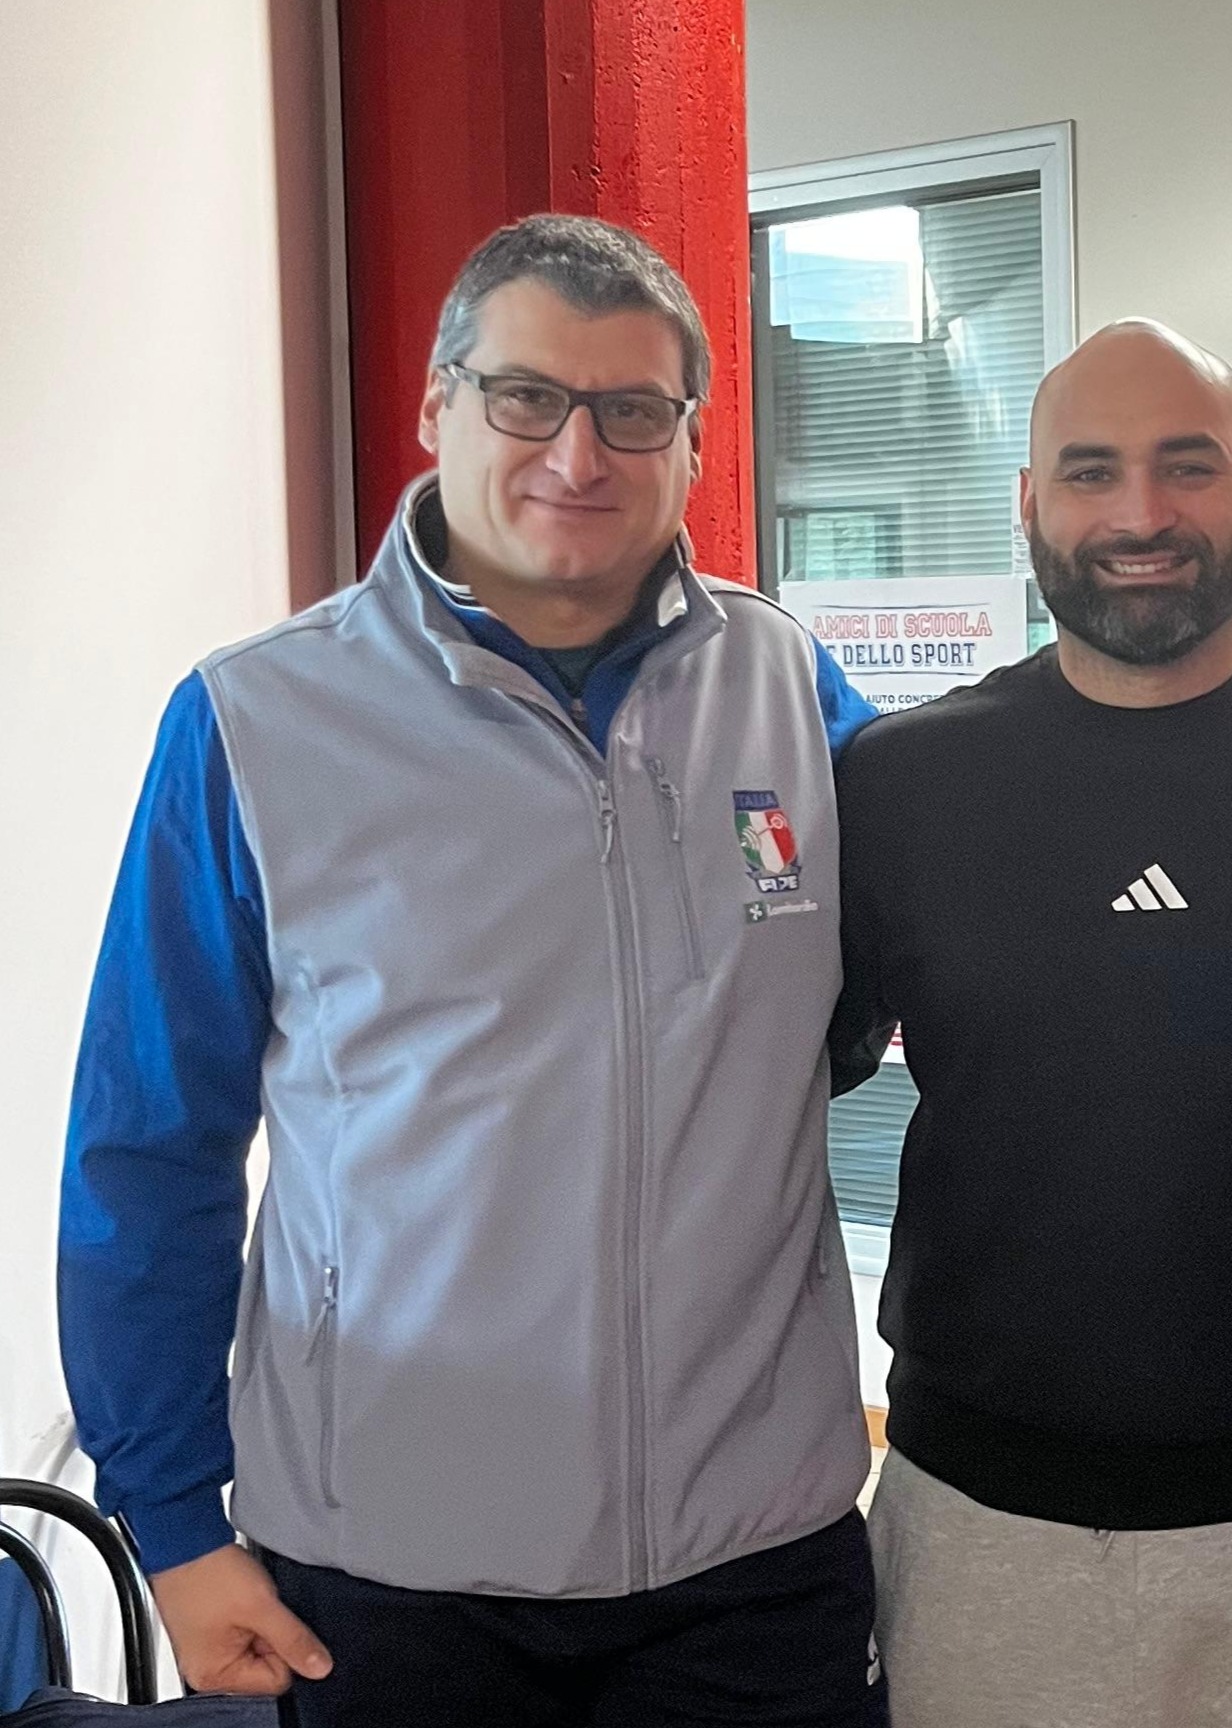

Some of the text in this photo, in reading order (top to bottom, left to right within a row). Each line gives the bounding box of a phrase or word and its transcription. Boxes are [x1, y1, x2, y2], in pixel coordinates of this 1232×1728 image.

[813, 612, 992, 639] AMICI DI SCUOLA
[843, 644, 904, 666] DELLO
[911, 643, 976, 666] SPORT
